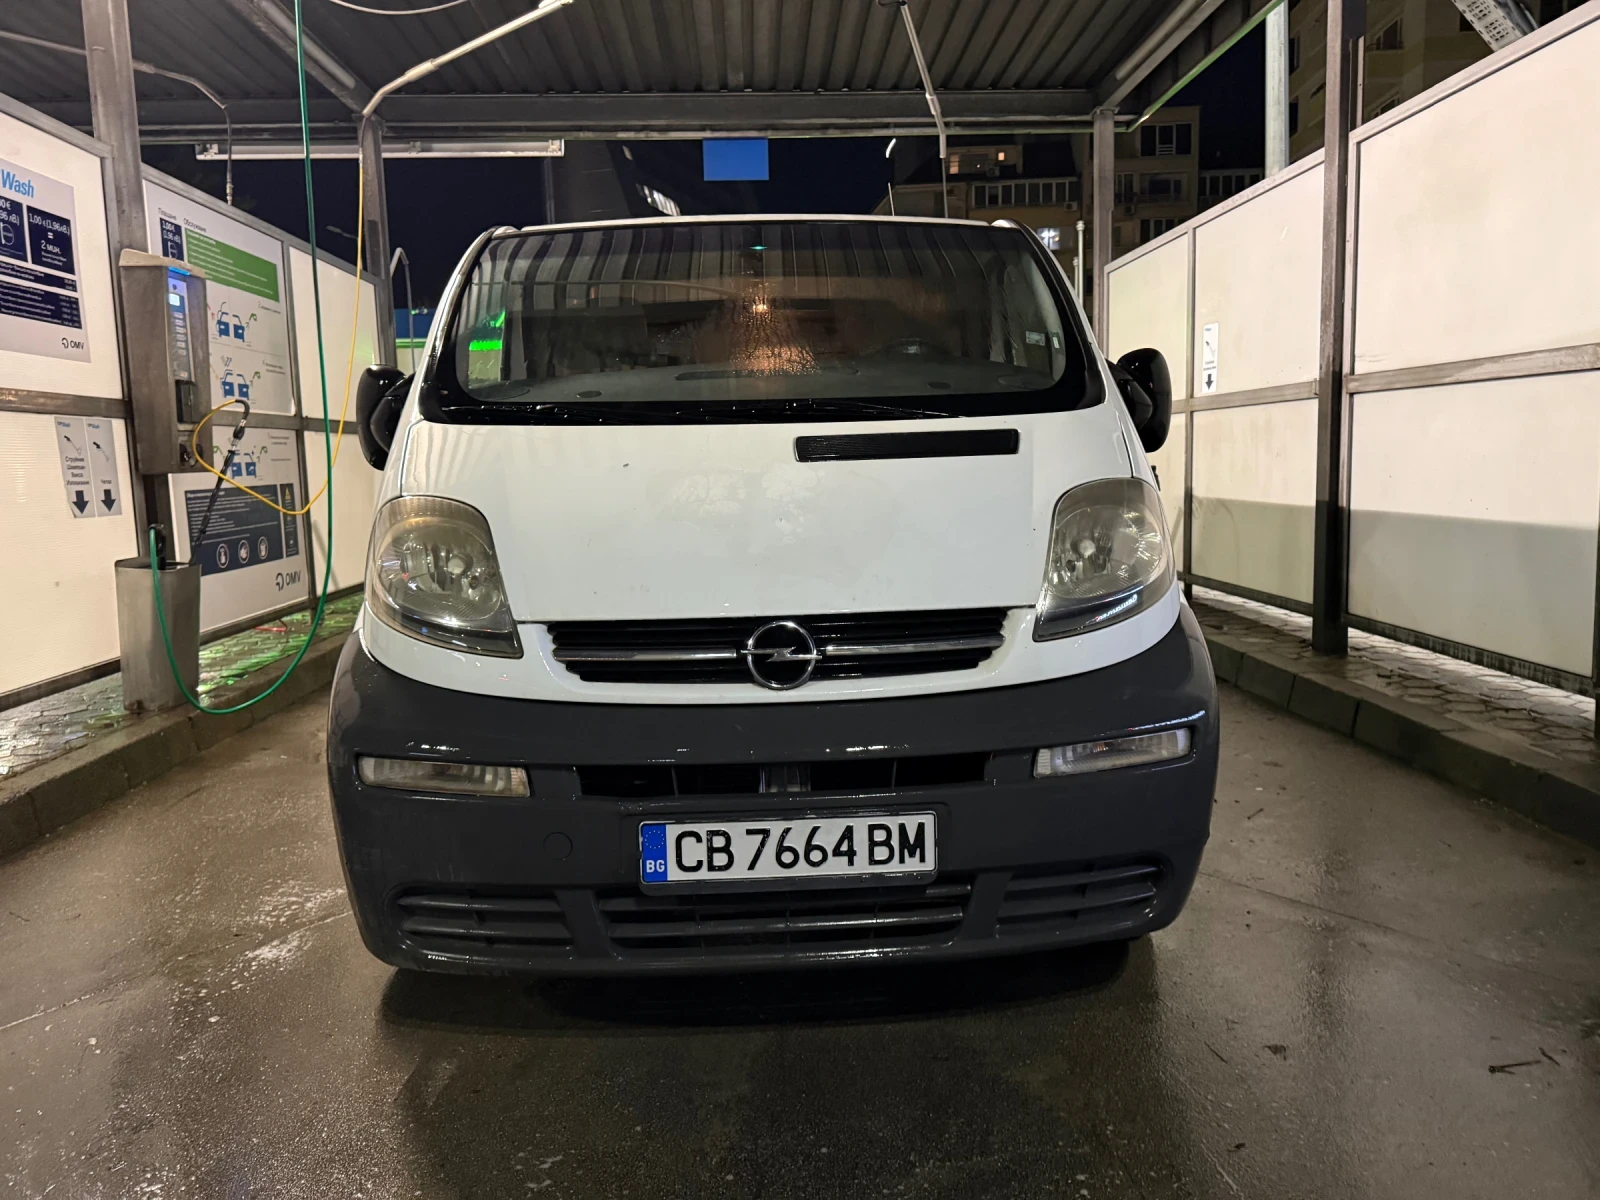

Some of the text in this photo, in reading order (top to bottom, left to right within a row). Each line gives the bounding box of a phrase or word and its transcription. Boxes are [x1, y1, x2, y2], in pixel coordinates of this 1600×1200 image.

[1, 169, 34, 198] Wash
[70, 340, 84, 350] OMV
[285, 570, 301, 586] OMV
[675, 821, 926, 872] CB 7664 BM
[646, 860, 665, 873] BG
